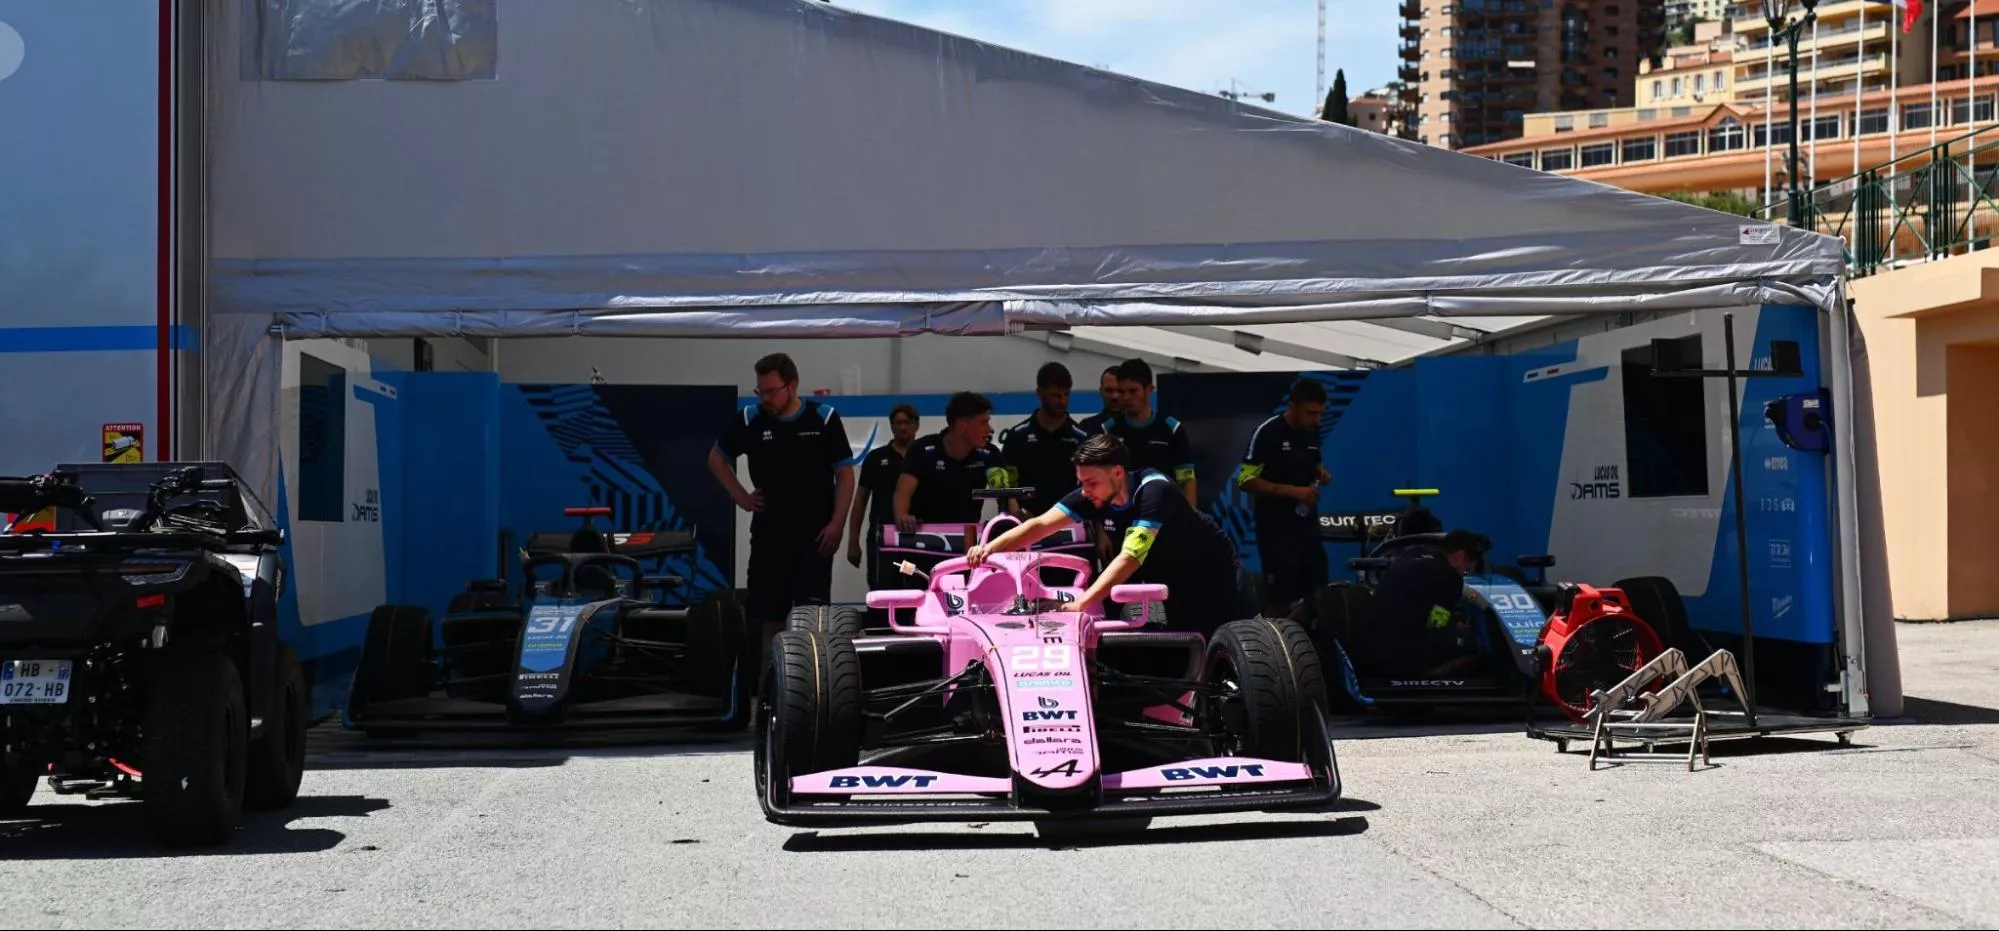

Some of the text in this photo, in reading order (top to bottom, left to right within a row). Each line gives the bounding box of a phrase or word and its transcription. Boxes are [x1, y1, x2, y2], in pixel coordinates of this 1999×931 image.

[1490, 594, 1534, 609] 30
[528, 616, 576, 633] 31
[1011, 645, 1071, 670] 29
[21, 663, 40, 677] HB
[1023, 710, 1078, 721] BWT
[1024, 736, 1081, 744] dallara
[1161, 764, 1264, 781] BWT
[829, 775, 938, 788] BWT
